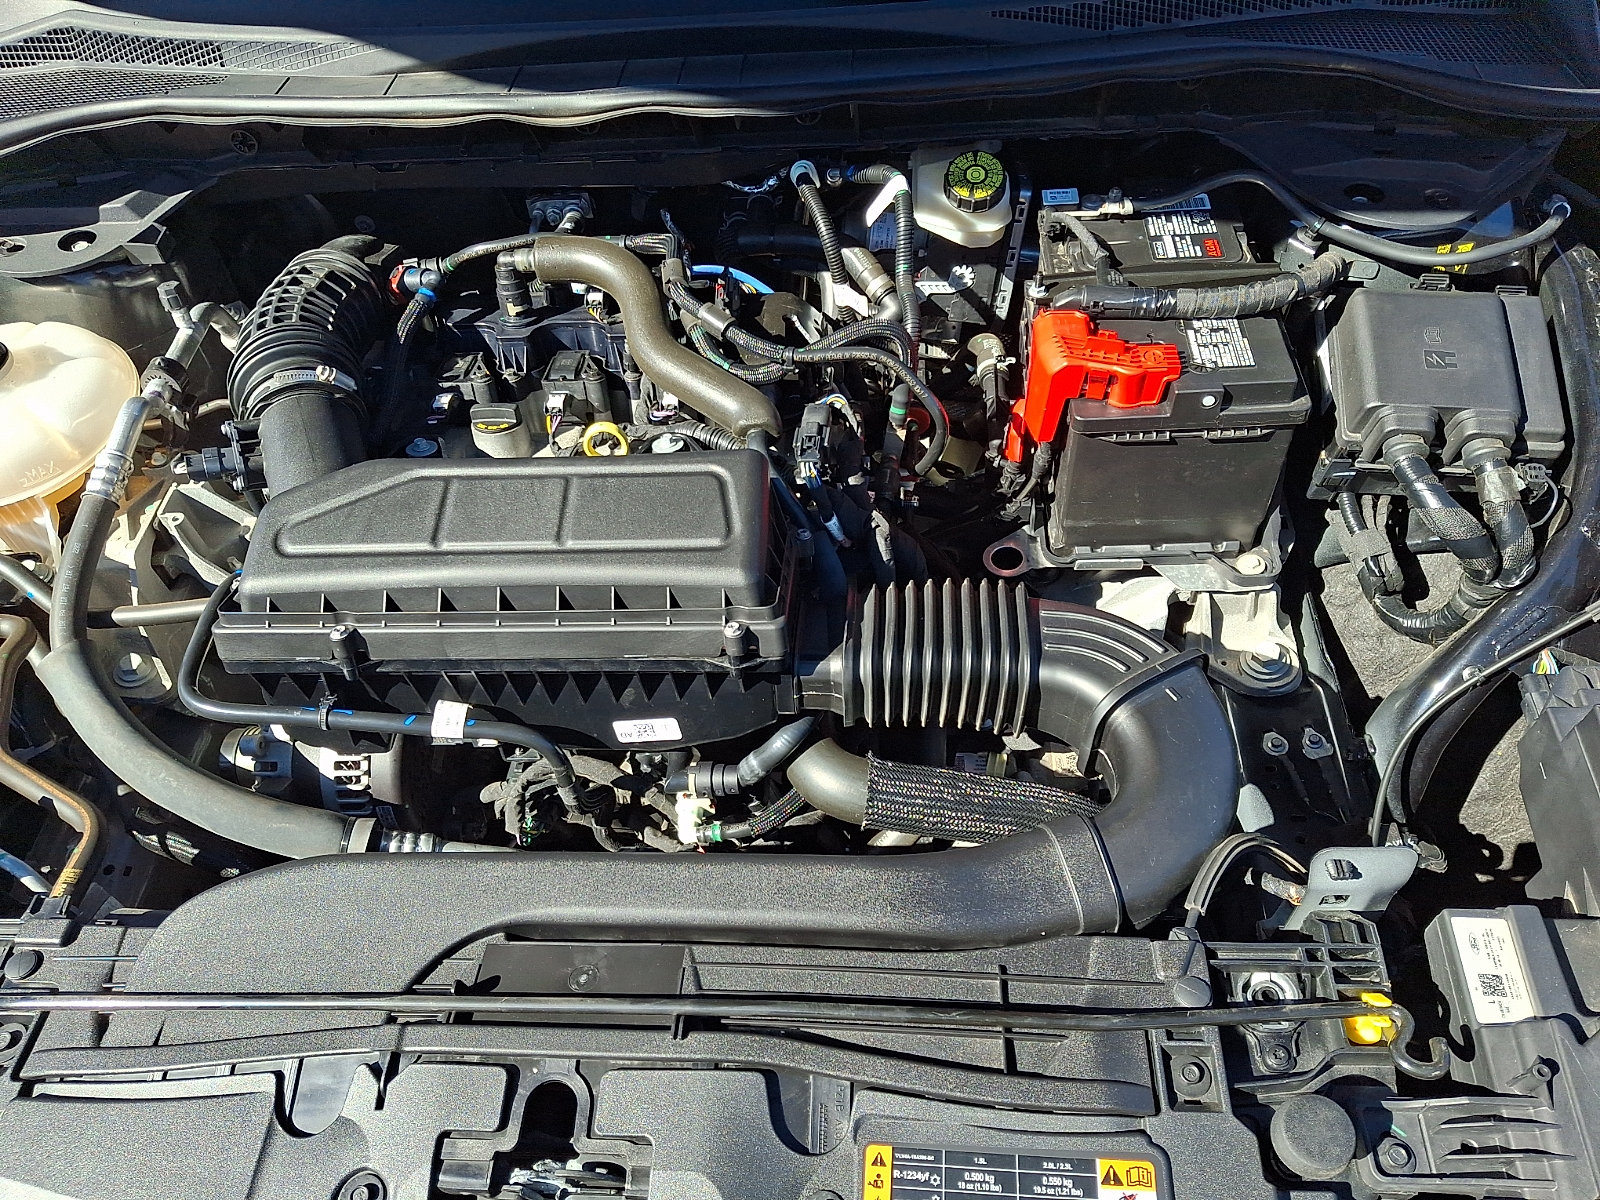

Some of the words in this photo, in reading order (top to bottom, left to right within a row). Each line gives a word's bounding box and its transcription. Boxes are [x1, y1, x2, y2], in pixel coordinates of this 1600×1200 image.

[1203, 238, 1218, 257] AGM
[893, 1169, 930, 1182] R-1234yf
[964, 1171, 984, 1182] 0.500
[985, 1172, 995, 1184] kg
[958, 1181, 966, 1189] 18
[974, 1182, 990, 1192] (1.10
[990, 1184, 1002, 1193] lbs)
[1042, 1176, 1062, 1186] 0.550
[1062, 1177, 1073, 1188] kg
[1033, 1185, 1047, 1194] 19.5
[1055, 1187, 1071, 1197] (1.21
[1070, 1187, 1084, 1197] lbs)
